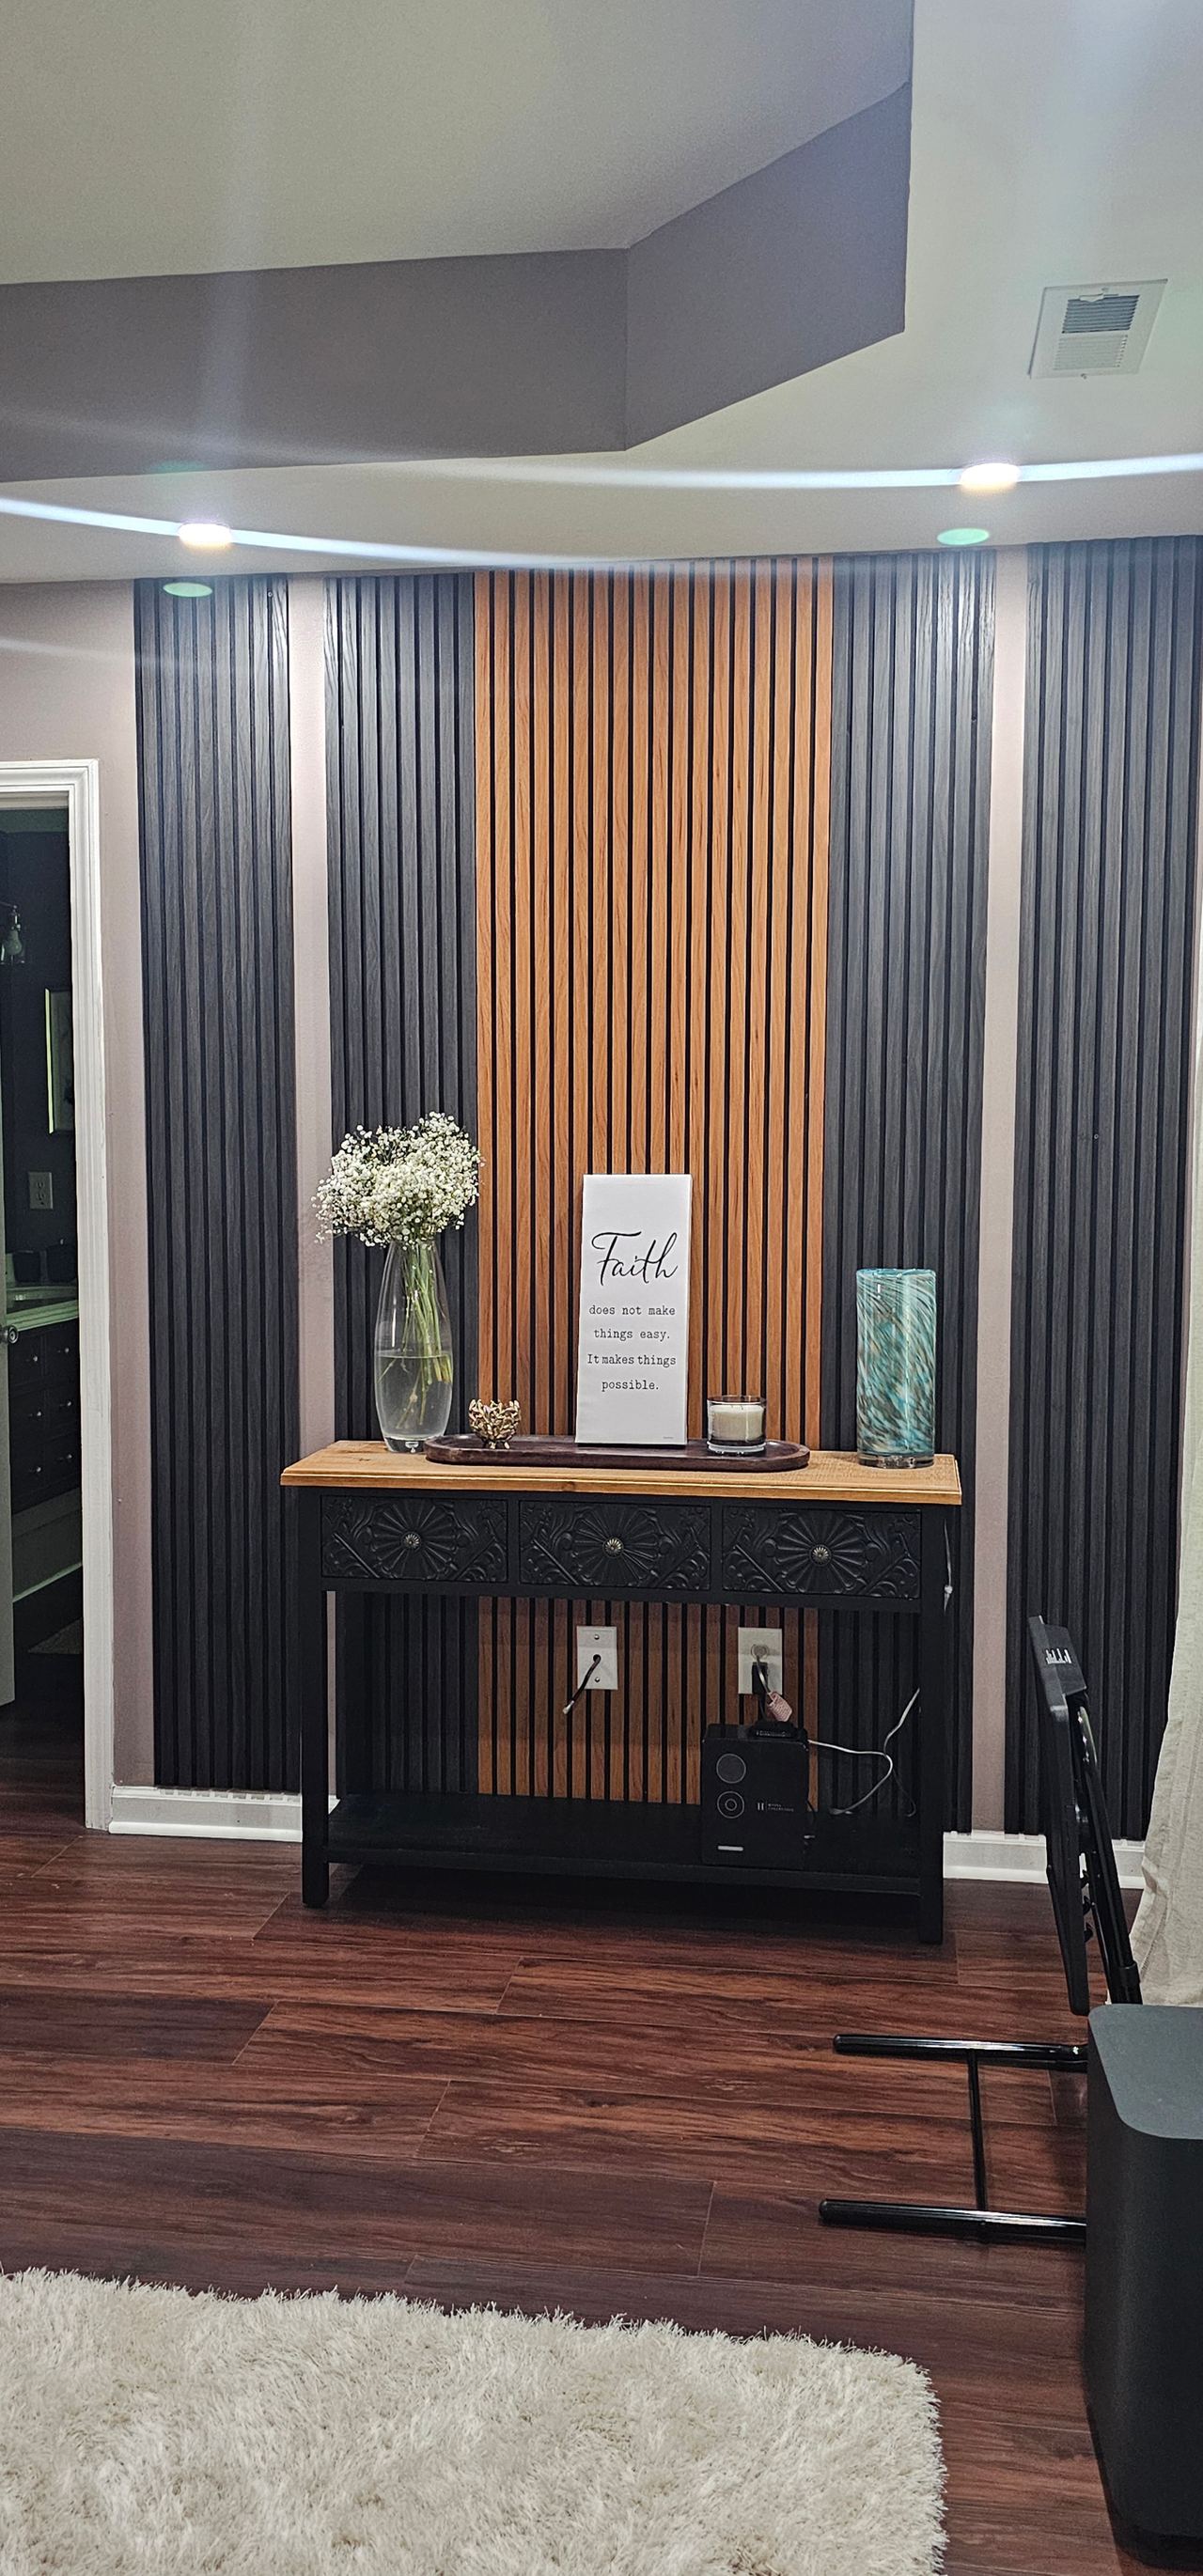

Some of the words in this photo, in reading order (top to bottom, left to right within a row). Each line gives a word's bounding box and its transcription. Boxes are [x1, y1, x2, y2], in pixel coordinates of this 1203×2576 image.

[591, 1231, 679, 1287] Faith
[588, 1304, 616, 1316] does
[621, 1305, 642, 1316] not
[648, 1305, 676, 1316] make
[594, 1328, 633, 1341] things
[639, 1330, 670, 1341] easy.
[587, 1353, 600, 1365] It
[602, 1353, 634, 1366] makes
[637, 1354, 677, 1367] things
[602, 1379, 659, 1392] possible.
